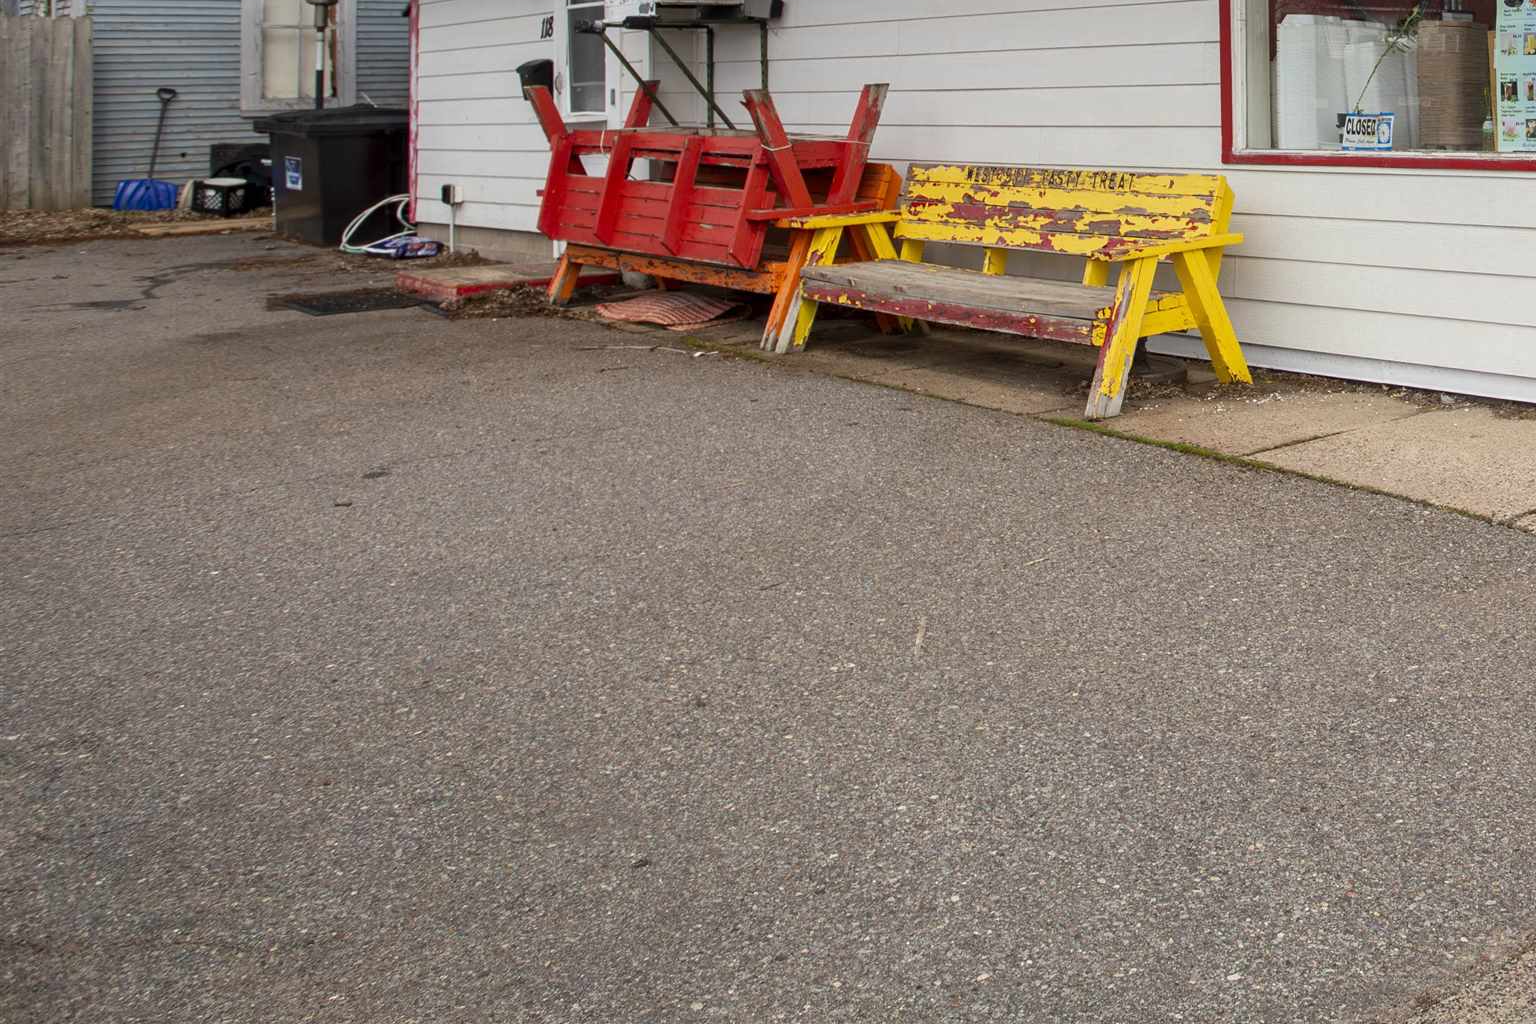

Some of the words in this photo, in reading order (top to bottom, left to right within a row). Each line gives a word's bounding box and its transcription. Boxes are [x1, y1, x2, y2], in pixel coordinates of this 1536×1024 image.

[540, 16, 554, 39] 118
[1346, 118, 1376, 136] CLOSED
[1041, 169, 1080, 189] TASTY
[1092, 172, 1136, 191] TREAT
